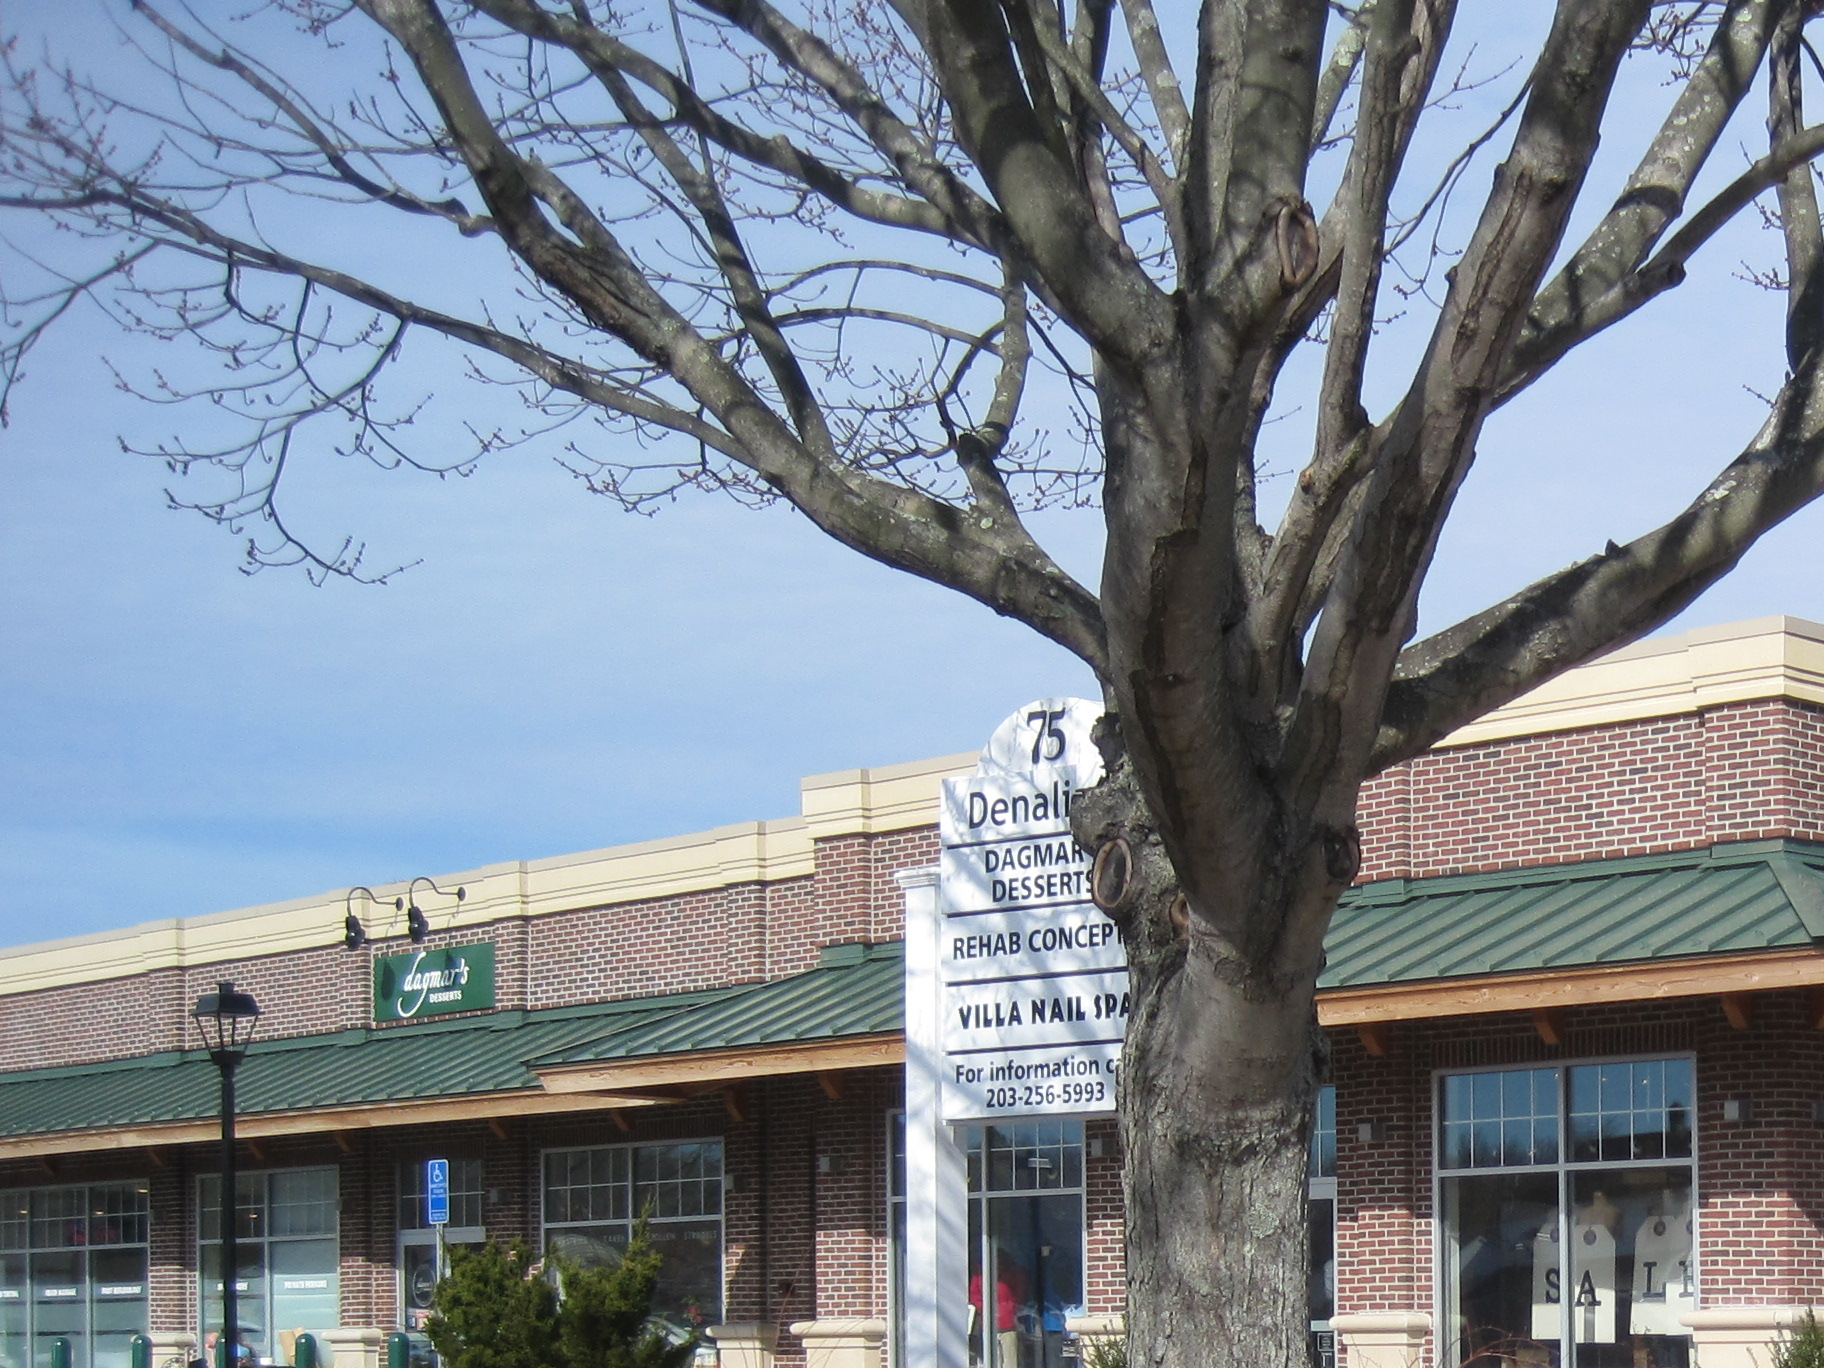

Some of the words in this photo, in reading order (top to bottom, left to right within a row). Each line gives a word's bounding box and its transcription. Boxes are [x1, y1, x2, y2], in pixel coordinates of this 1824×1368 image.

[1027, 707, 1066, 764] 75
[969, 780, 1070, 829] Denali
[985, 841, 1084, 873] DAGMAR
[953, 932, 1021, 960] REHAB
[429, 989, 462, 1004] DESSERTS
[958, 1000, 1022, 1030] VILLA
[1031, 996, 1086, 1025] NAIL
[1094, 992, 1130, 1020] SPA
[955, 1064, 984, 1084] For
[989, 1055, 1100, 1081] information
[986, 1081, 1105, 1108] 203-256-5993
